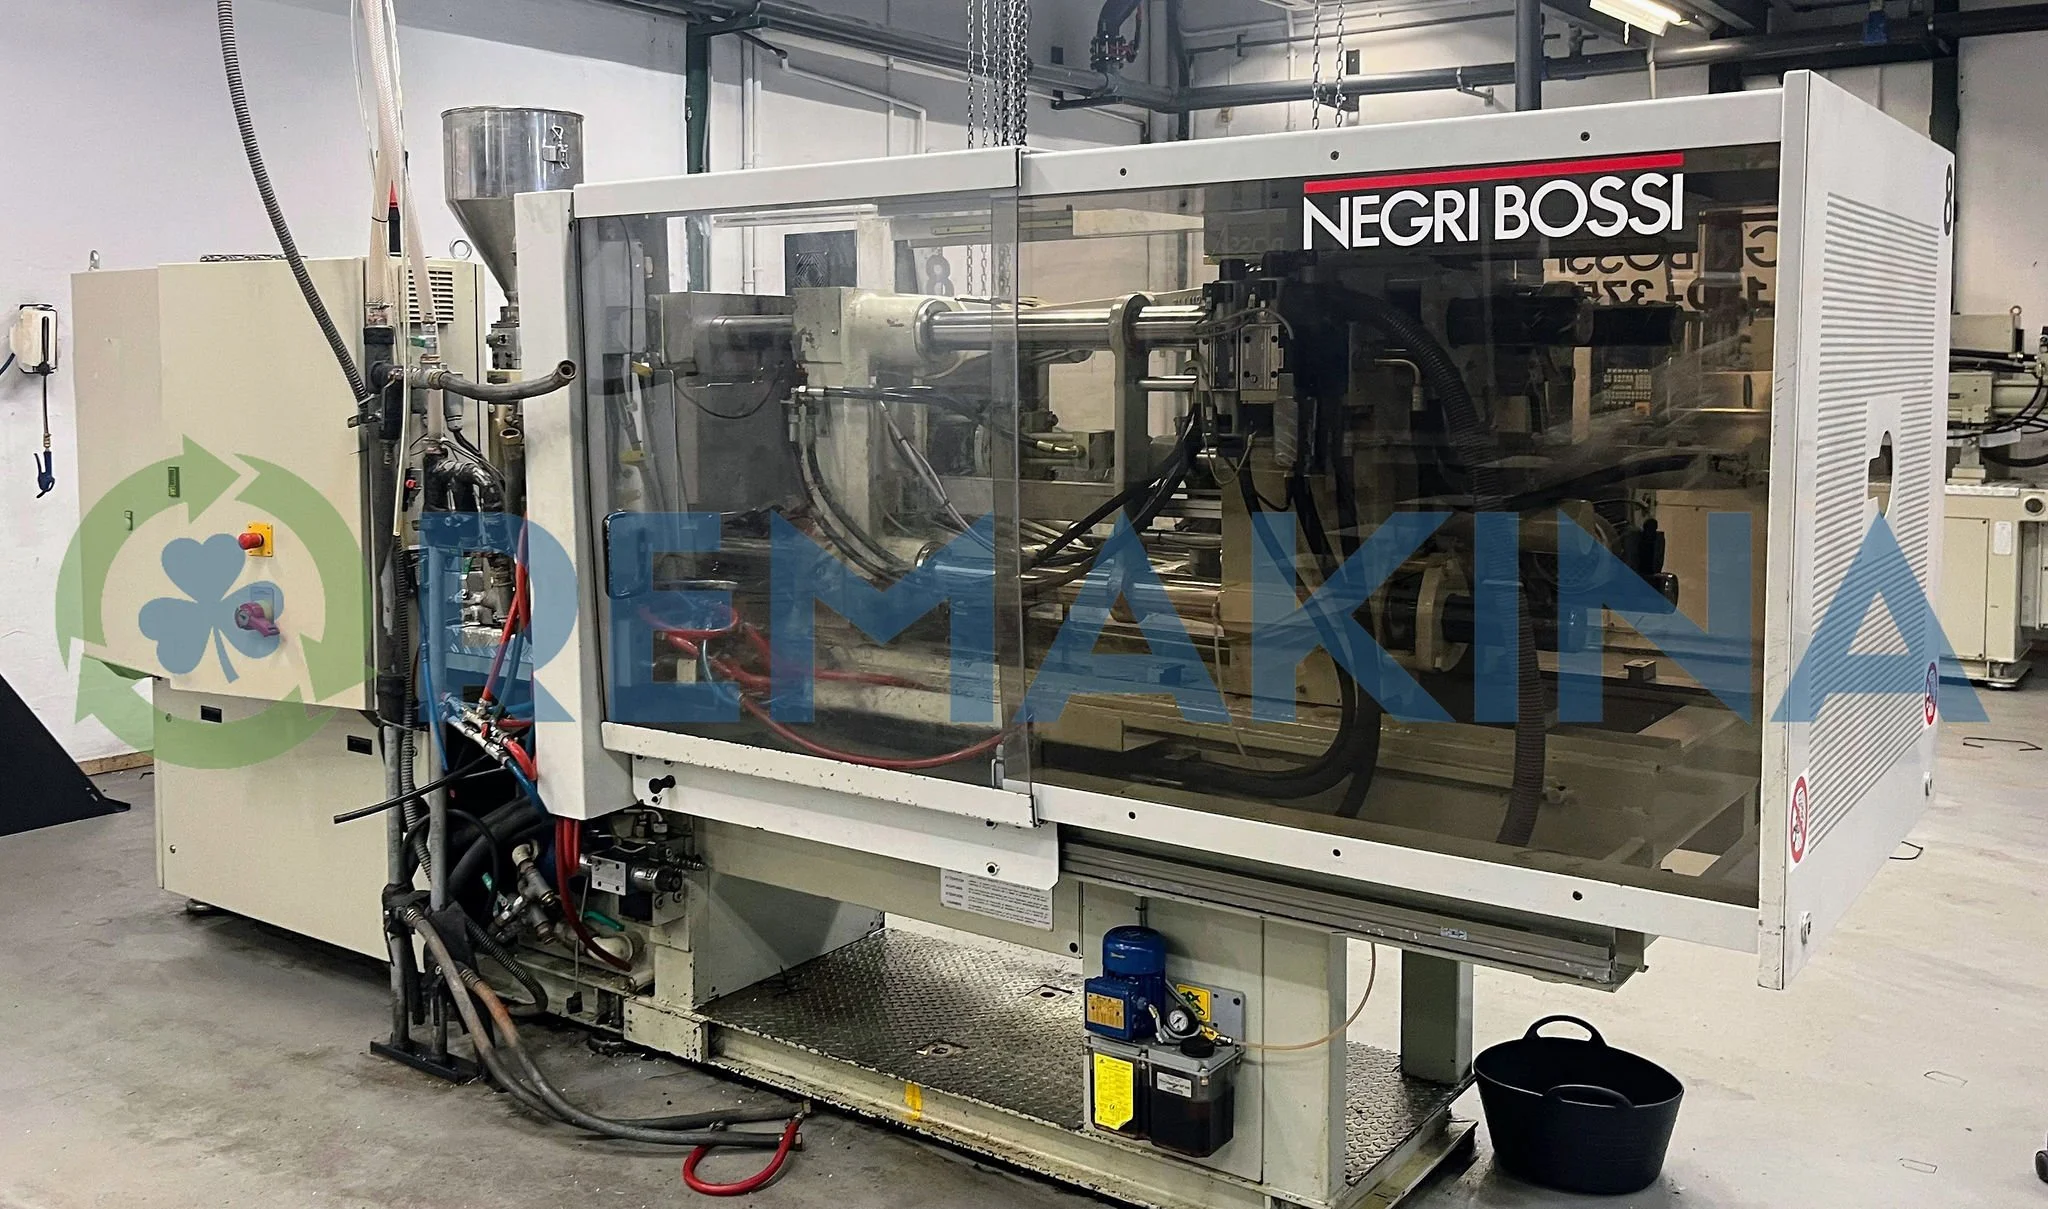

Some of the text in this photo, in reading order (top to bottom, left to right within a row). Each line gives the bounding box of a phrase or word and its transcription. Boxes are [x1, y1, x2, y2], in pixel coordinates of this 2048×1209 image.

[1303, 172, 1684, 251] NEGRI BOSSI
[1944, 163, 1953, 237] 8
